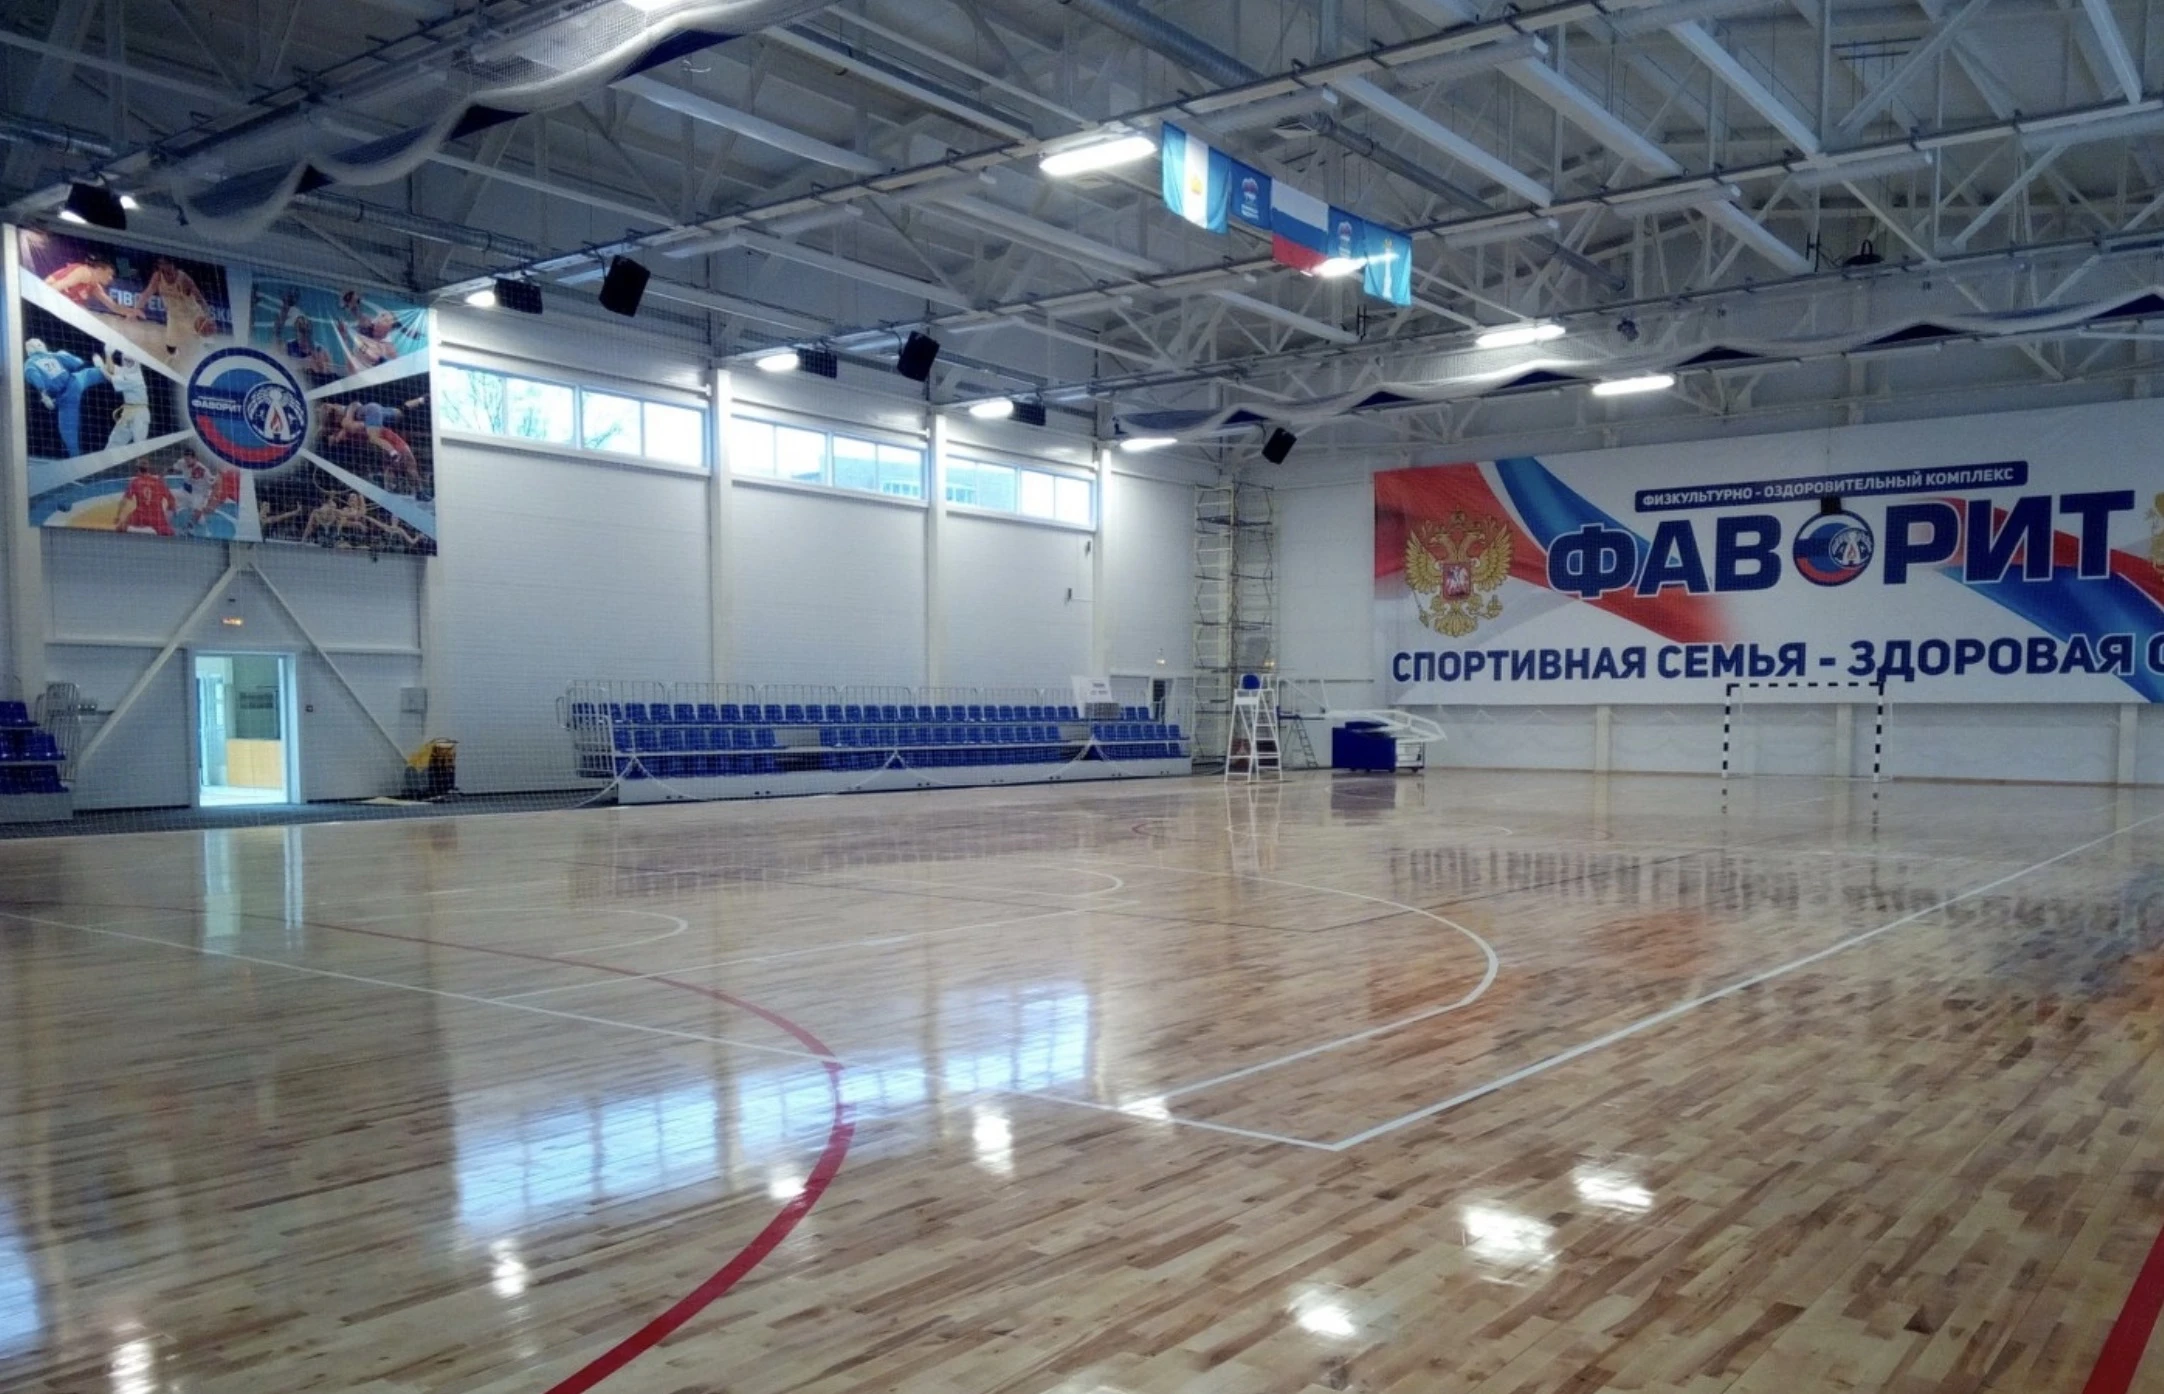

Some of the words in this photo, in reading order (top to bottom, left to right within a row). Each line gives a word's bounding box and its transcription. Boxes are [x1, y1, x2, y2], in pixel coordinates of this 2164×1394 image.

[1643, 487, 1752, 506] ФИЗКУЛЬТУРНО
[1764, 471, 1922, 498] ОЗДОРОВИТЕЛЬНЫЙ
[1926, 468, 2014, 486] КОМПЛЕКС
[1547, 490, 2135, 600] ФАВОРИТ
[1392, 646, 1647, 682] СПОРТИВНАЯ
[1657, 641, 1807, 678] СЕМЬЯ
[1847, 633, 2136, 683] ЗДОРОВАЯ
